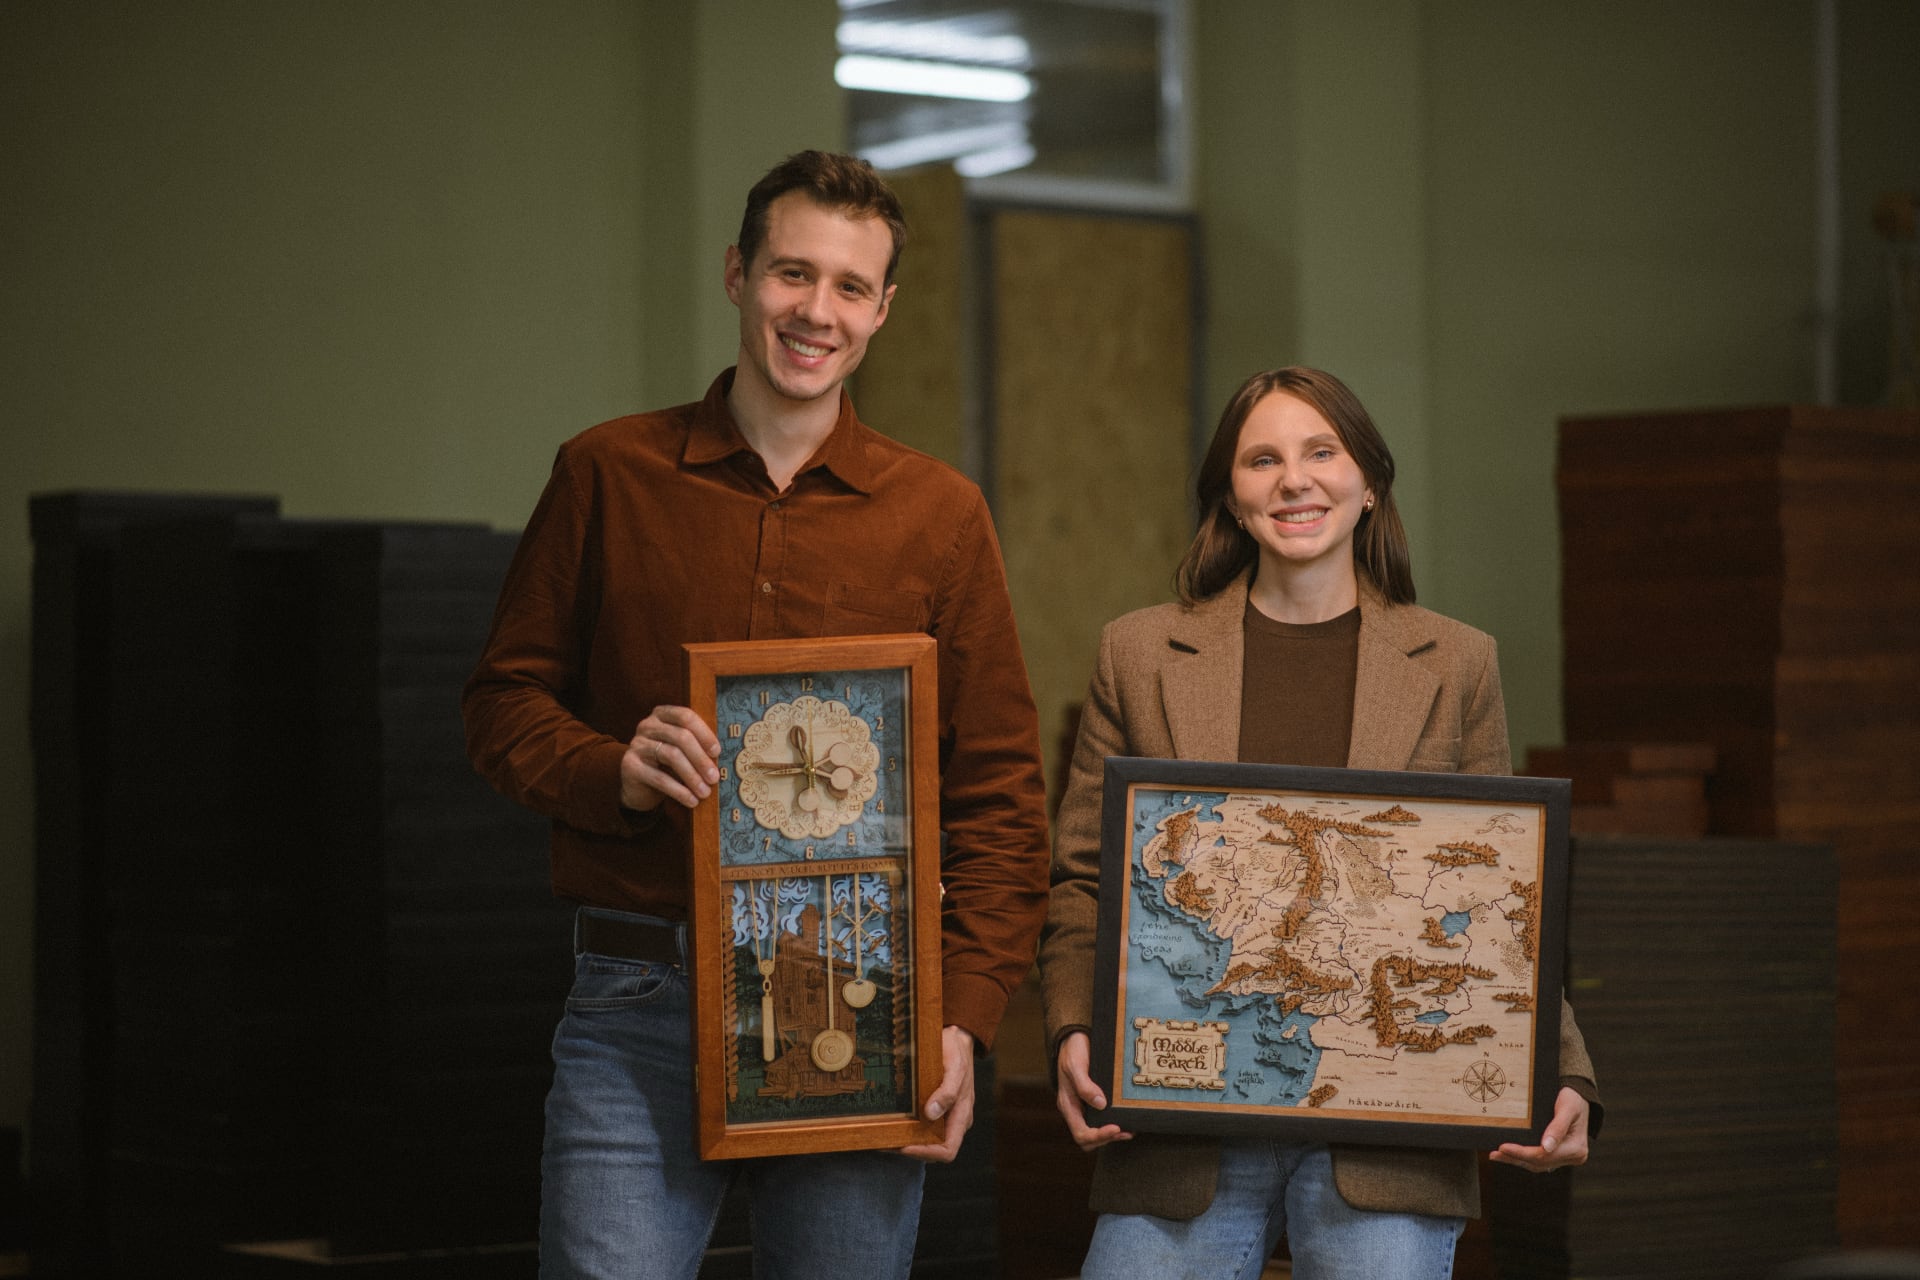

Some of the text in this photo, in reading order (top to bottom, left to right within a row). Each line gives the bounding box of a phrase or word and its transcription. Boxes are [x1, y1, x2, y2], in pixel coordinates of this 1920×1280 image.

[800, 678, 814, 693] 12
[845, 685, 851, 701] 1
[759, 690, 771, 705] 11
[728, 723, 742, 738] 10
[875, 716, 885, 731] 2
[887, 758, 897, 772] 3
[719, 767, 728, 781] 9
[876, 799, 886, 814] 4
[731, 807, 742, 822] 8
[762, 836, 772, 852] 7
[847, 831, 857, 846] 5
[805, 845, 815, 860] 6
[1481, 1106, 1488, 1114] S
